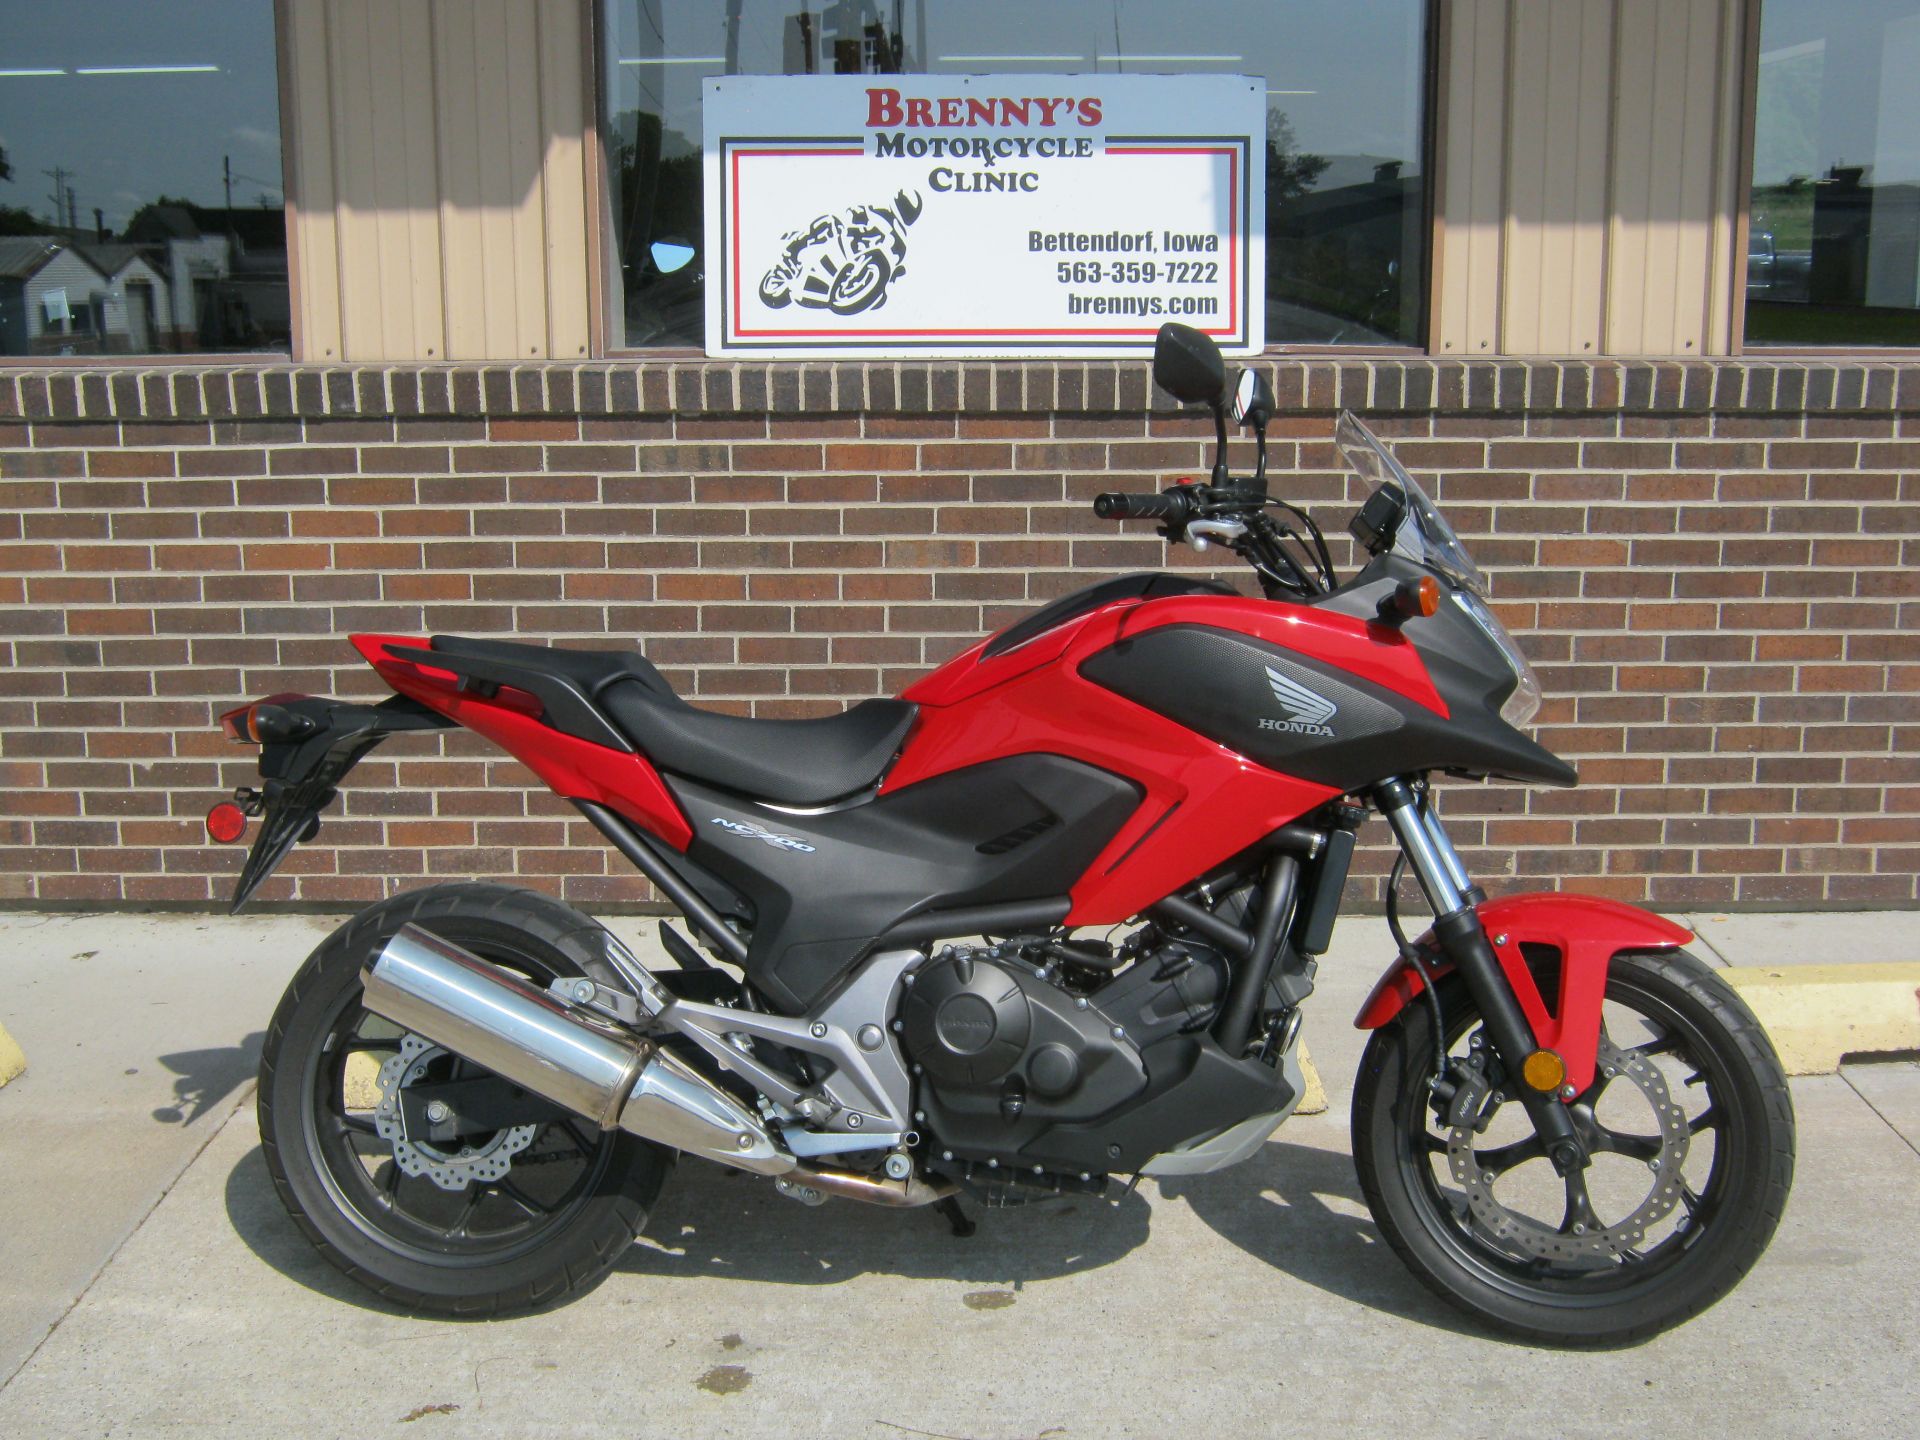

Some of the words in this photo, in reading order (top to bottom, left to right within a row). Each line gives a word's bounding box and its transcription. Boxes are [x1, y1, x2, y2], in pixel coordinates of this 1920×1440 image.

[865, 88, 1103, 127] BRENNY'S
[875, 132, 1094, 167] MOTORCYCLE
[928, 167, 1039, 192] CLINIC
[1028, 230, 1158, 254] Bettendorf,
[1163, 231, 1219, 252] Iowa
[1057, 261, 1218, 283] 563-359-7222
[1068, 293, 1218, 316] brennys.com
[1258, 718, 1335, 736] HONDA
